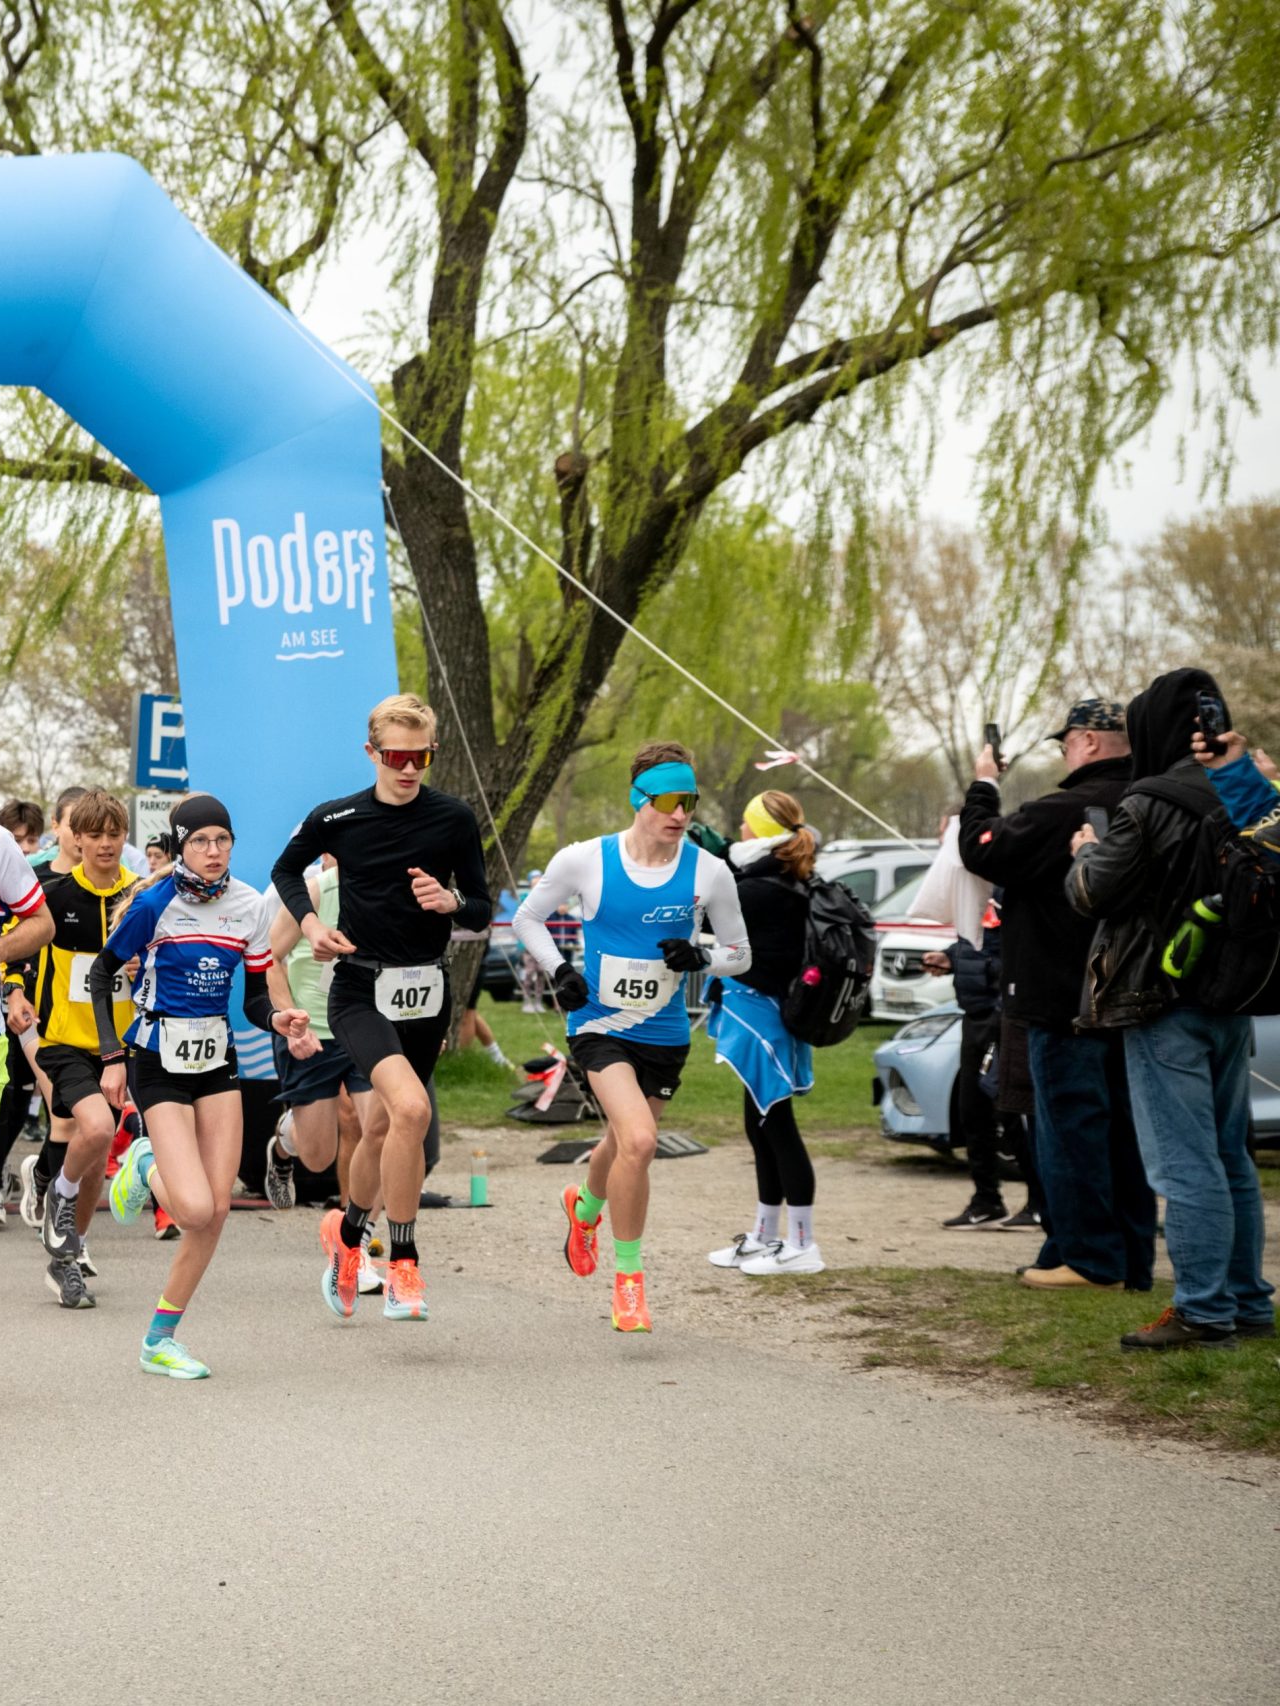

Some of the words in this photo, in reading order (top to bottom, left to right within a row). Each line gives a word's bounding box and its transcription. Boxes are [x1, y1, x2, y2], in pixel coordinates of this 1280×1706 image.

[280, 631, 305, 648] AM
[311, 628, 338, 646] SEE
[150, 701, 185, 762] P
[83, 973, 123, 993] 56
[613, 978, 660, 1000] 459
[390, 985, 432, 1009] 407
[175, 1037, 217, 1062] 476
